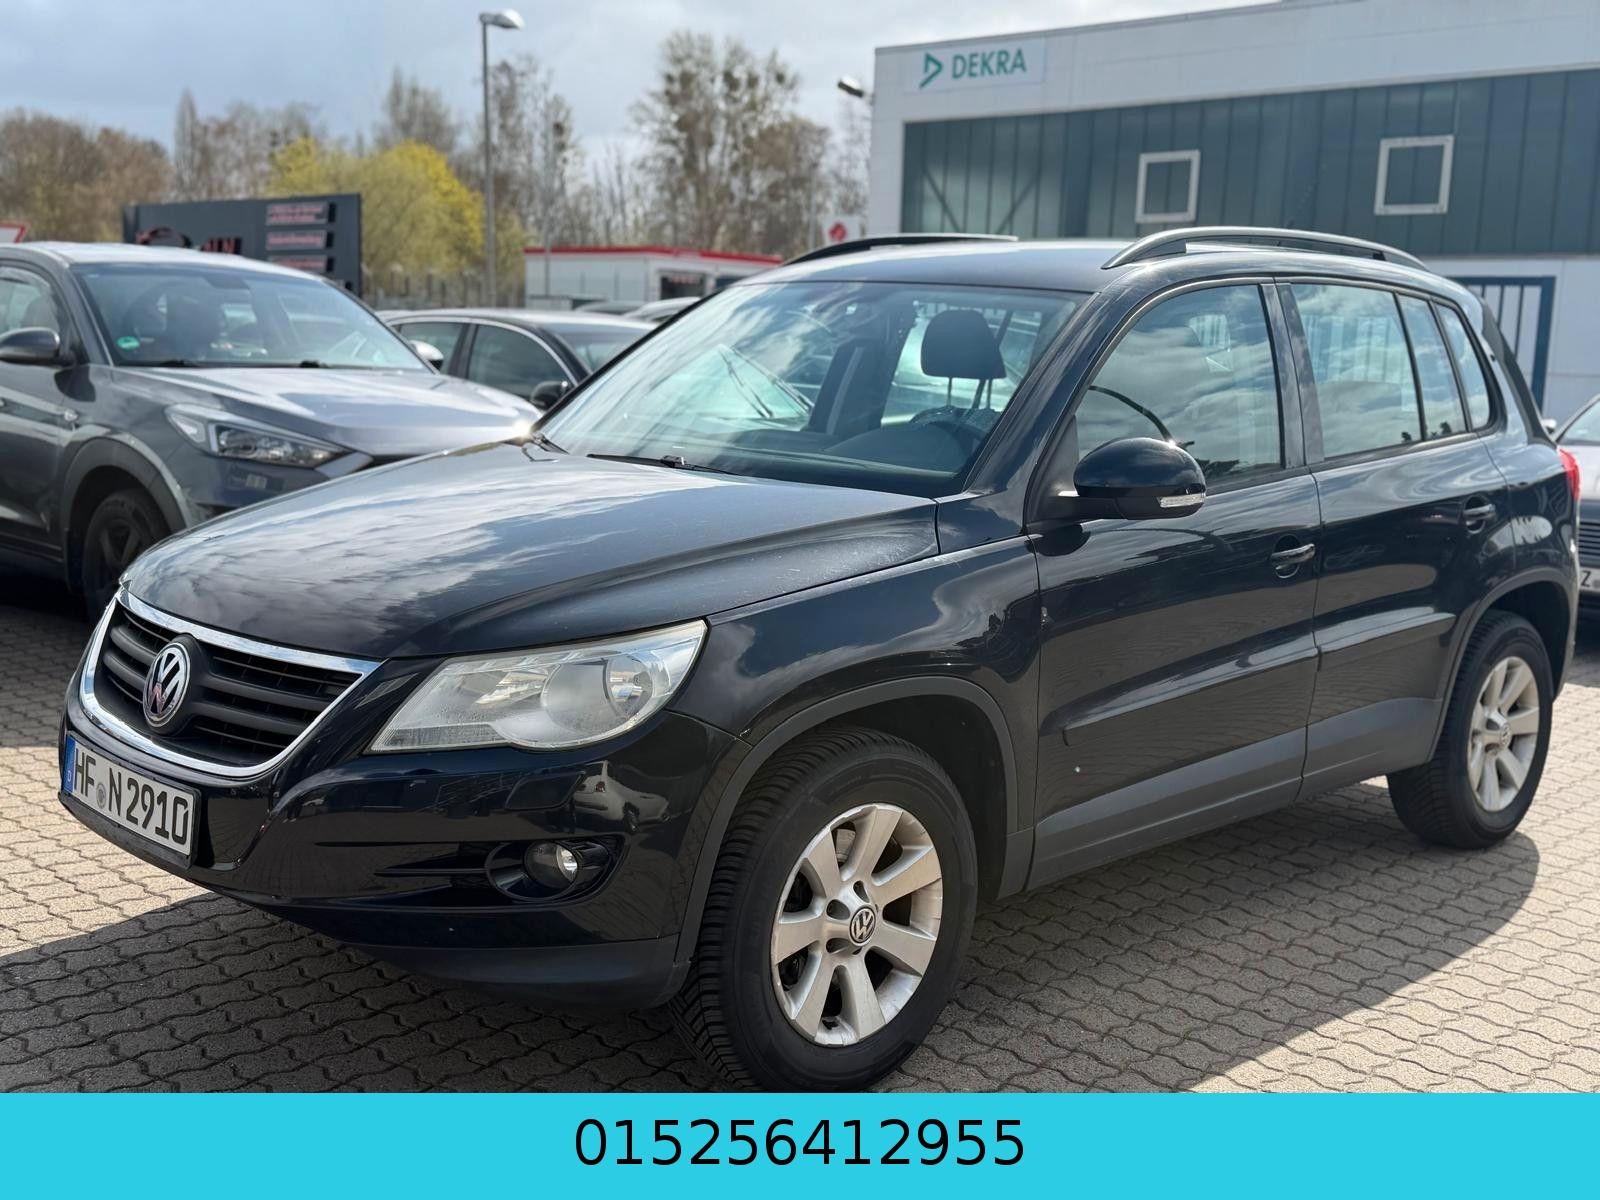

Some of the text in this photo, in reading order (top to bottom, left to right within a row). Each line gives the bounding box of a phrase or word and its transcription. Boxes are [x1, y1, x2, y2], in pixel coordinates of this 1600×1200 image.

[952, 48, 1027, 79] DEKRA
[144, 643, 190, 727] VW
[74, 748, 189, 846] HF N 2910
